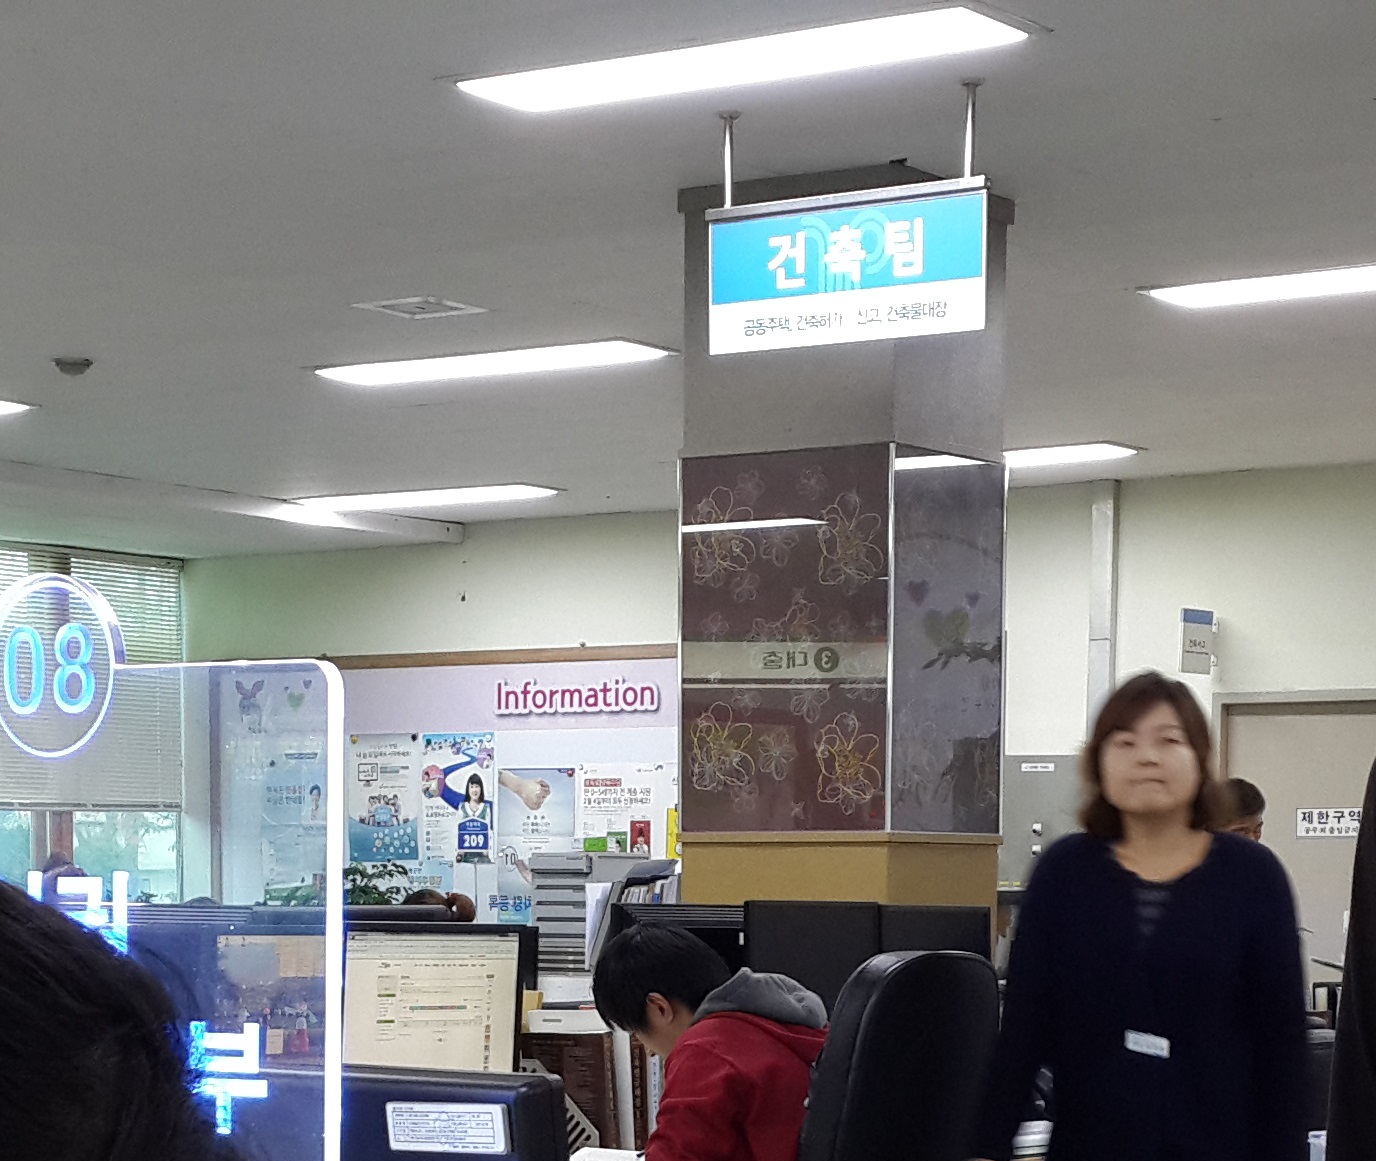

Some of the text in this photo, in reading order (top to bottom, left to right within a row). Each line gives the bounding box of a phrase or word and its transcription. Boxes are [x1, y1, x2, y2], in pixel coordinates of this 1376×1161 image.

[767, 217, 925, 290] 건축팀
[3, 623, 95, 715] 08
[496, 681, 655, 711] Information
[1300, 810, 1361, 825] 제한구역
[463, 835, 484, 847] 209
